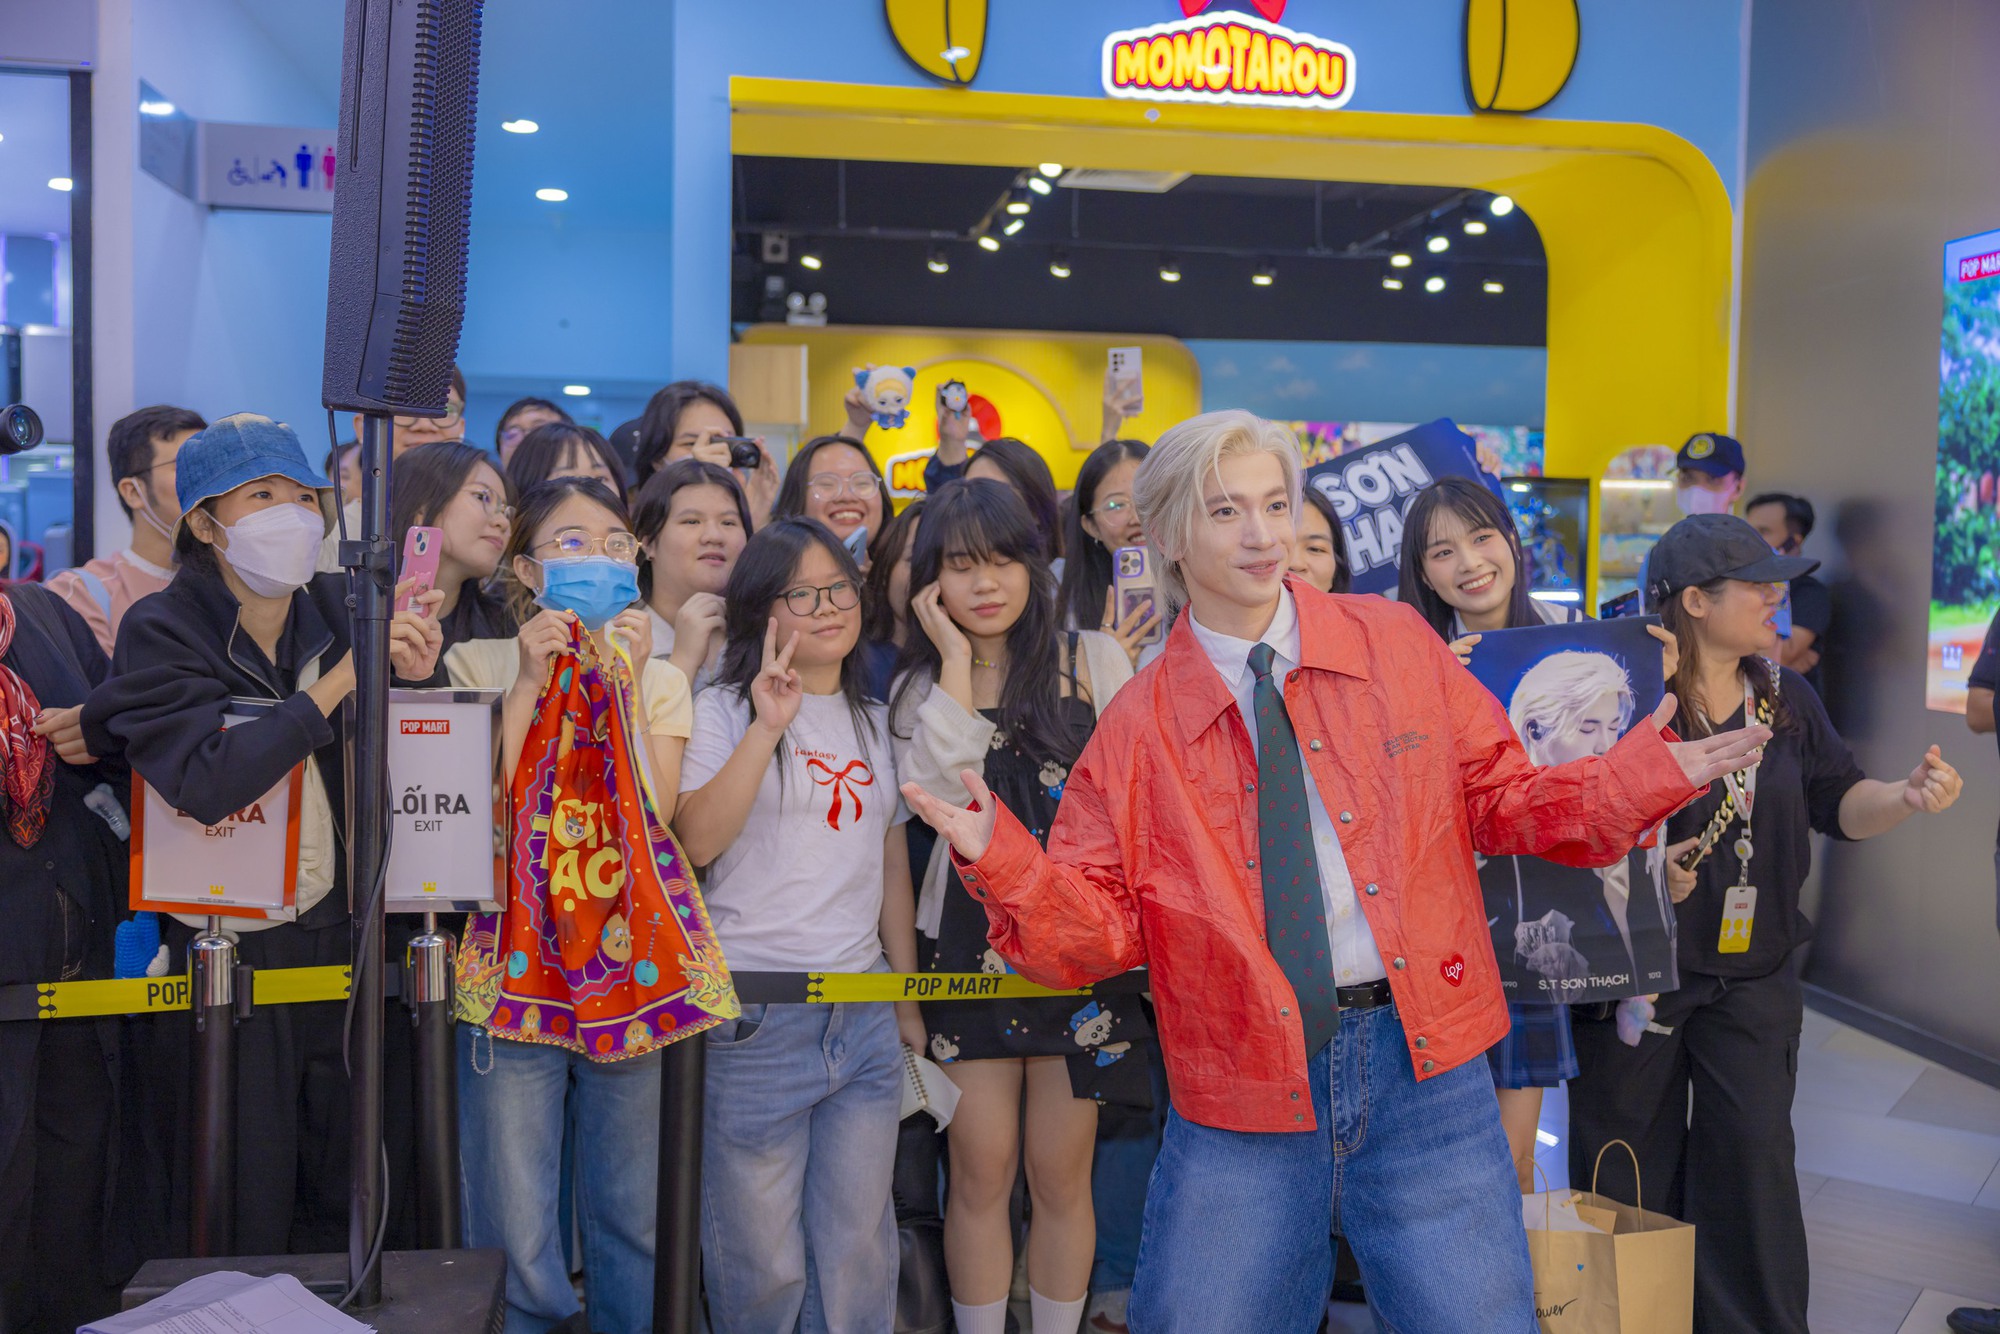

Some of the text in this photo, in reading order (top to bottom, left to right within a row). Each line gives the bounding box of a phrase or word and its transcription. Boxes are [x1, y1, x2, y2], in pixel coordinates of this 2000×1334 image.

[1113, 22, 1346, 97] MOMOTAROU
[1981, 252, 2000, 275] MAR
[892, 456, 931, 491] MO
[1311, 443, 1434, 520] SƠN
[402, 721, 448, 733] POP MART
[795, 746, 837, 762] fantasy
[435, 794, 471, 815] RA
[205, 825, 236, 838] EXIT
[414, 820, 443, 832] EXIT
[904, 976, 1003, 997] POP MART
[1538, 973, 1630, 990] S.T SƠN THẠCH
[147, 981, 188, 1007] POP
[1535, 1298, 1578, 1318] ower
